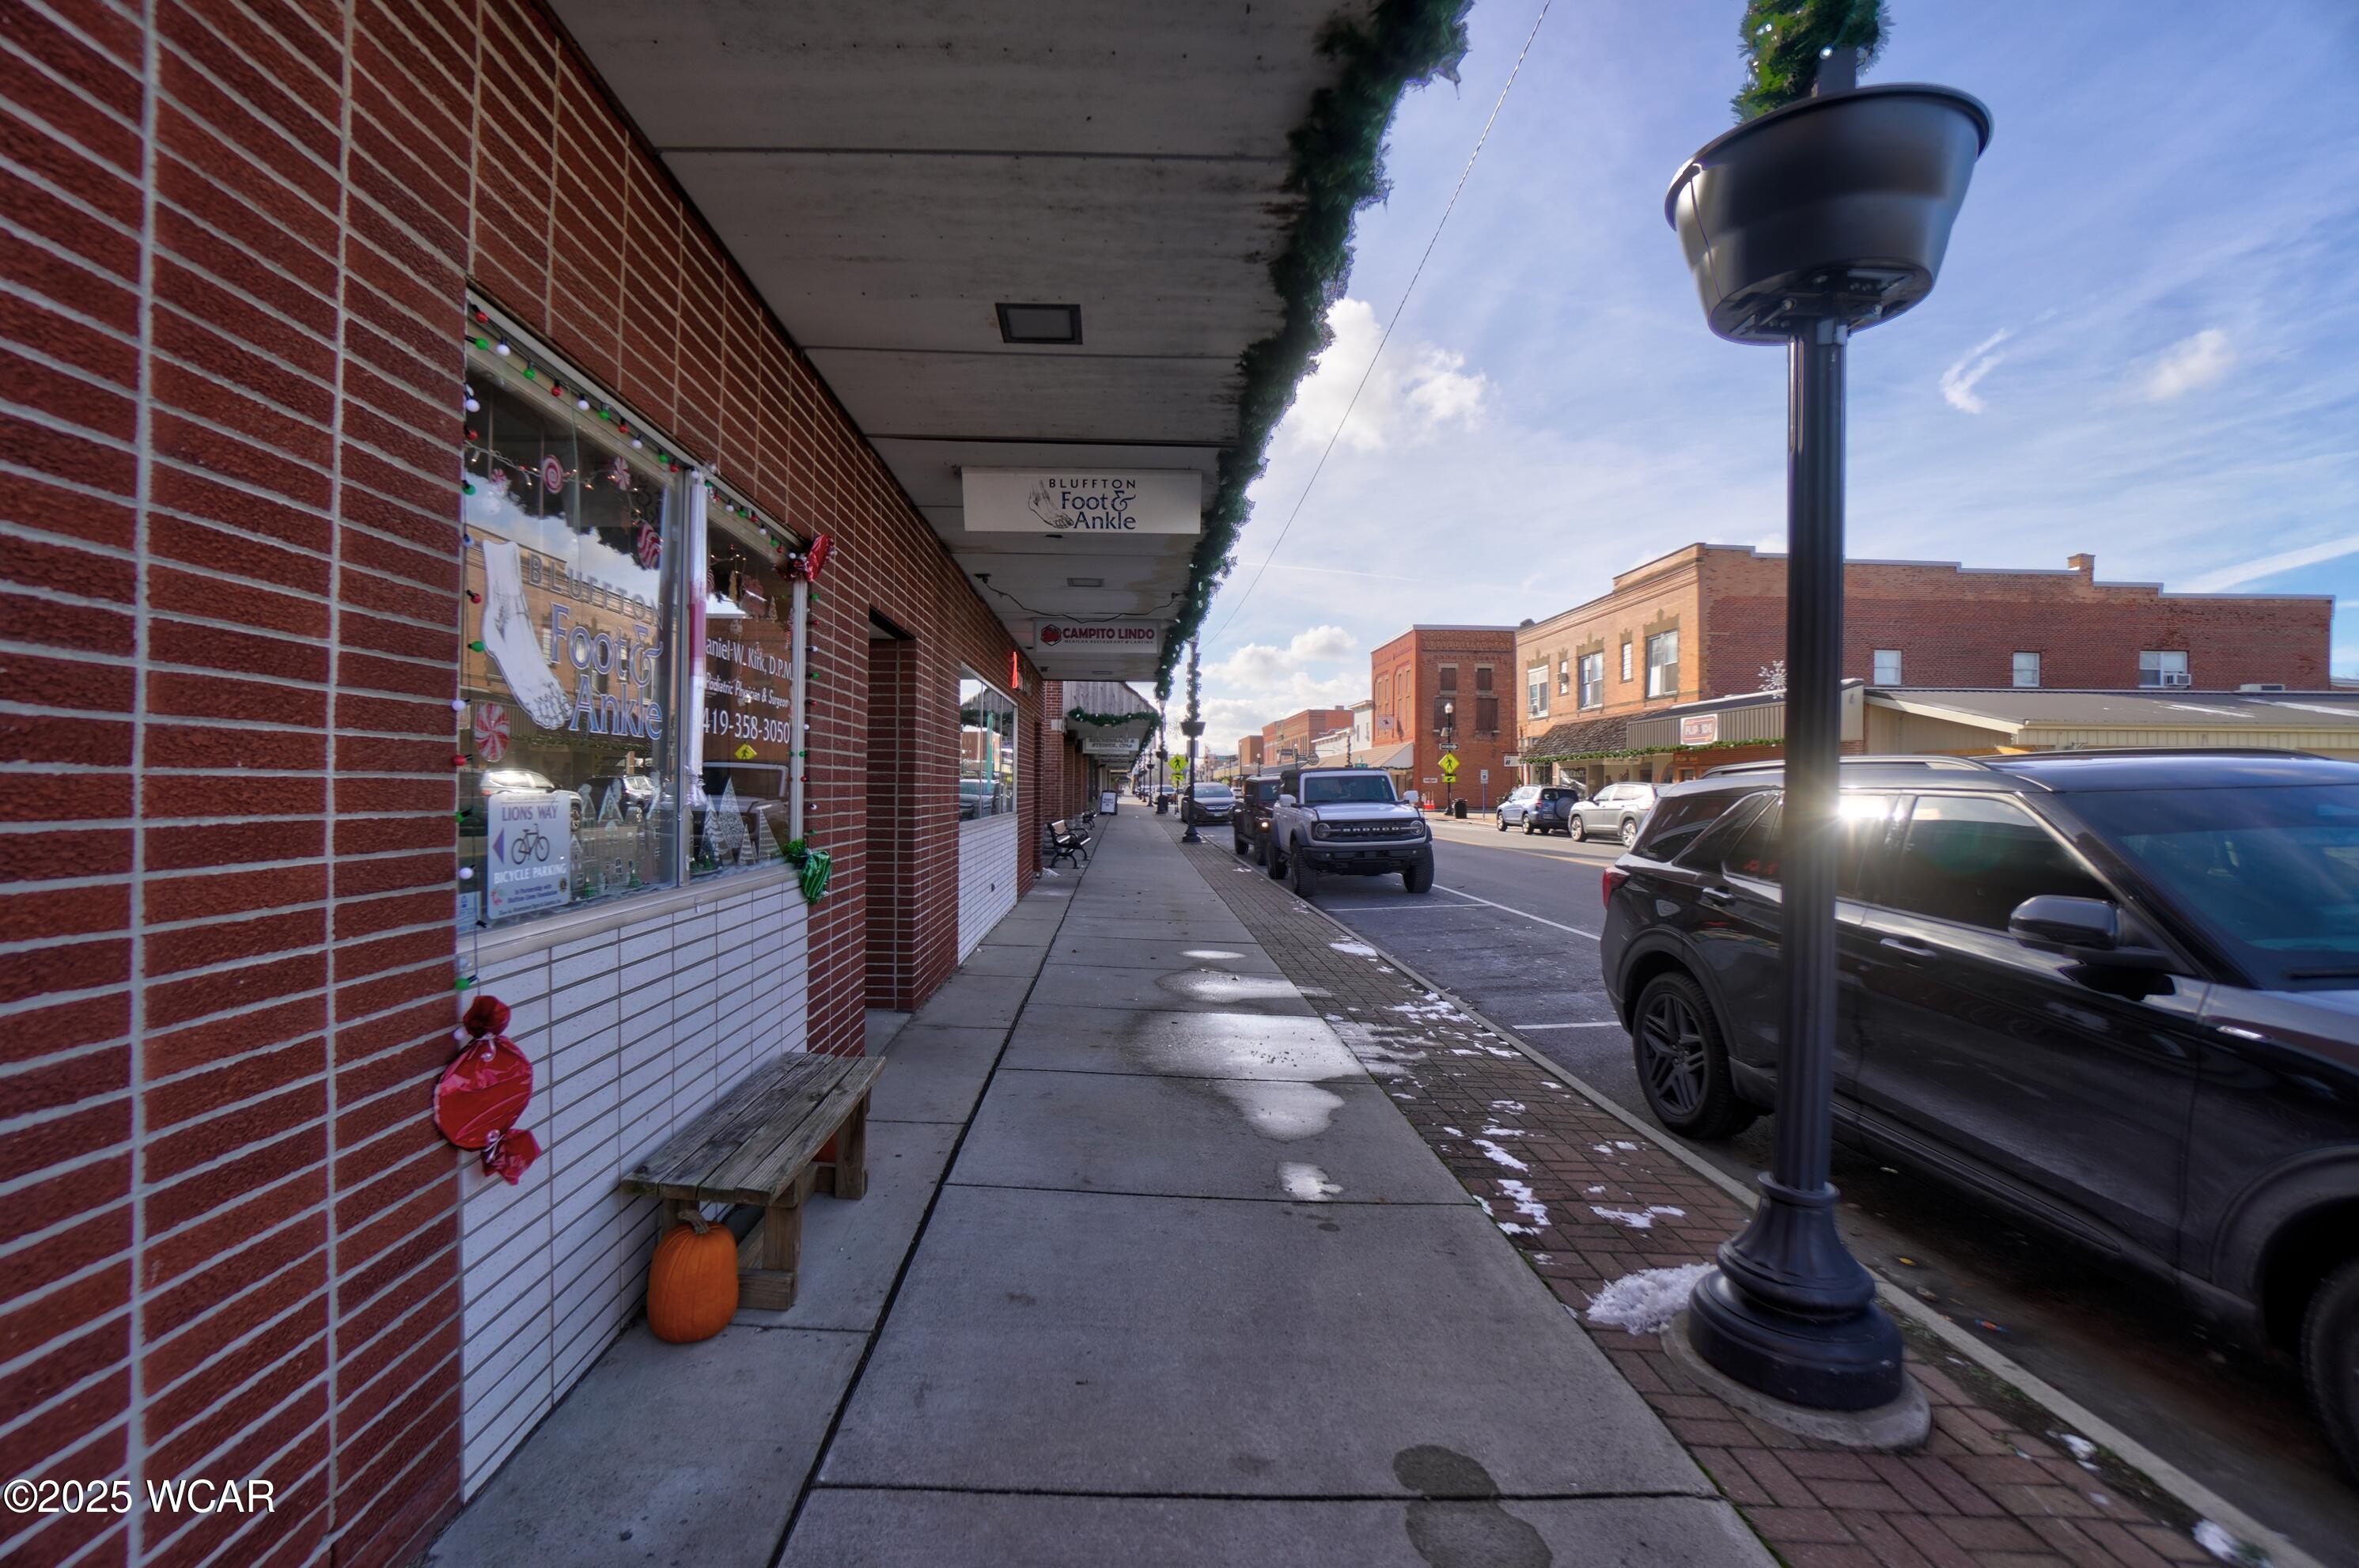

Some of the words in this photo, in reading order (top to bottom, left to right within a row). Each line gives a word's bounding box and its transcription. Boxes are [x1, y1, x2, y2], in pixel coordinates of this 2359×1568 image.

[1049, 479, 1136, 489] BLUFFTON
[1061, 491, 1108, 510] Foot
[1073, 511, 1136, 530] Ankle
[528, 553, 664, 632] BLUFFTON
[551, 602, 629, 680] Foot
[1063, 628, 1115, 639] CAMPITO
[1118, 628, 1154, 639] LINDO
[706, 637, 730, 661] aniel
[748, 647, 767, 675] Kirk,
[569, 674, 663, 740] Ankle
[735, 680, 760, 702] Physician
[768, 689, 789, 709] Surgeon
[702, 707, 790, 744] 419-358-3050
[502, 805, 532, 821] LIONS
[537, 805, 559, 820] WAY
[494, 868, 529, 884] BICYCLE
[533, 863, 566, 878] PARKING
